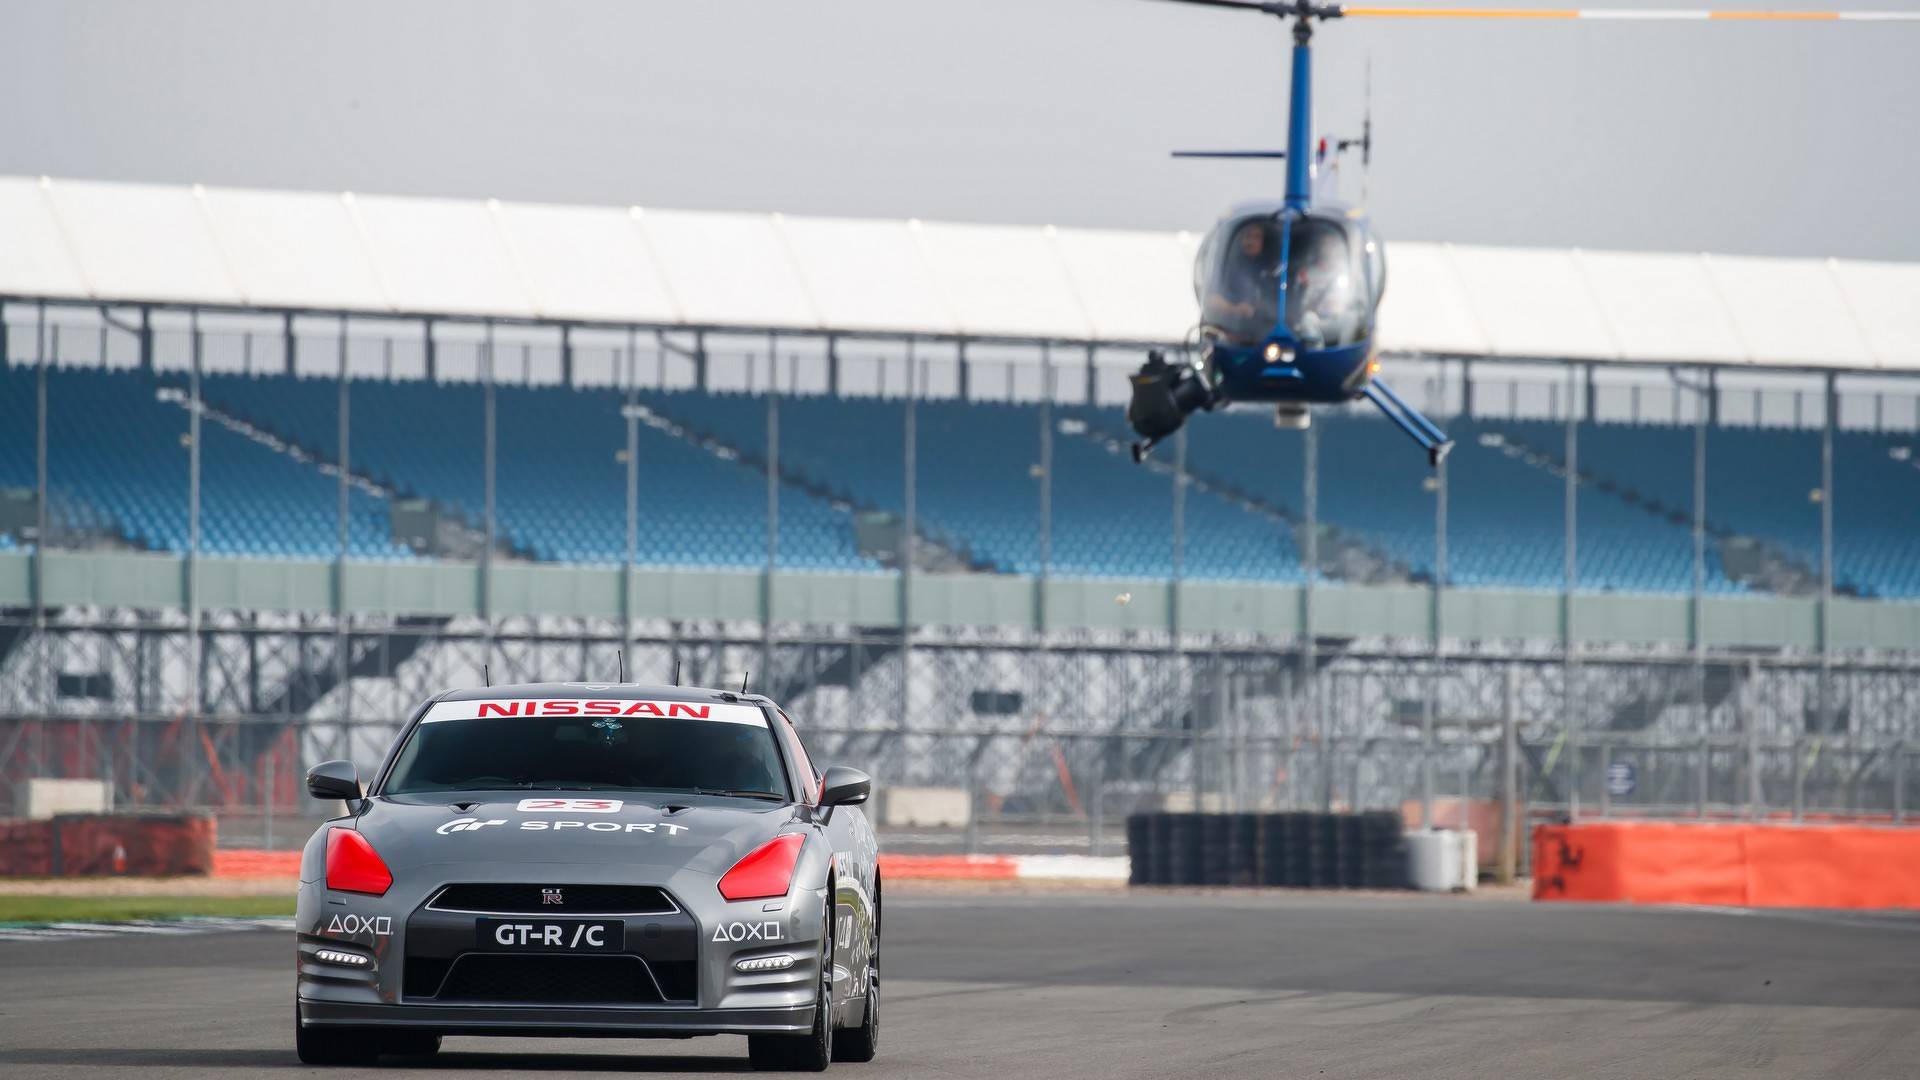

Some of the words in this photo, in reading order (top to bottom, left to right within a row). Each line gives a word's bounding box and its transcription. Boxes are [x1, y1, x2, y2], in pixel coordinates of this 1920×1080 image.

[477, 701, 711, 719] NISSAN
[526, 800, 612, 810] 23
[520, 820, 689, 836] SPORT
[542, 894, 564, 905] R
[495, 924, 563, 946] GT-R
[570, 924, 605, 948] /C
